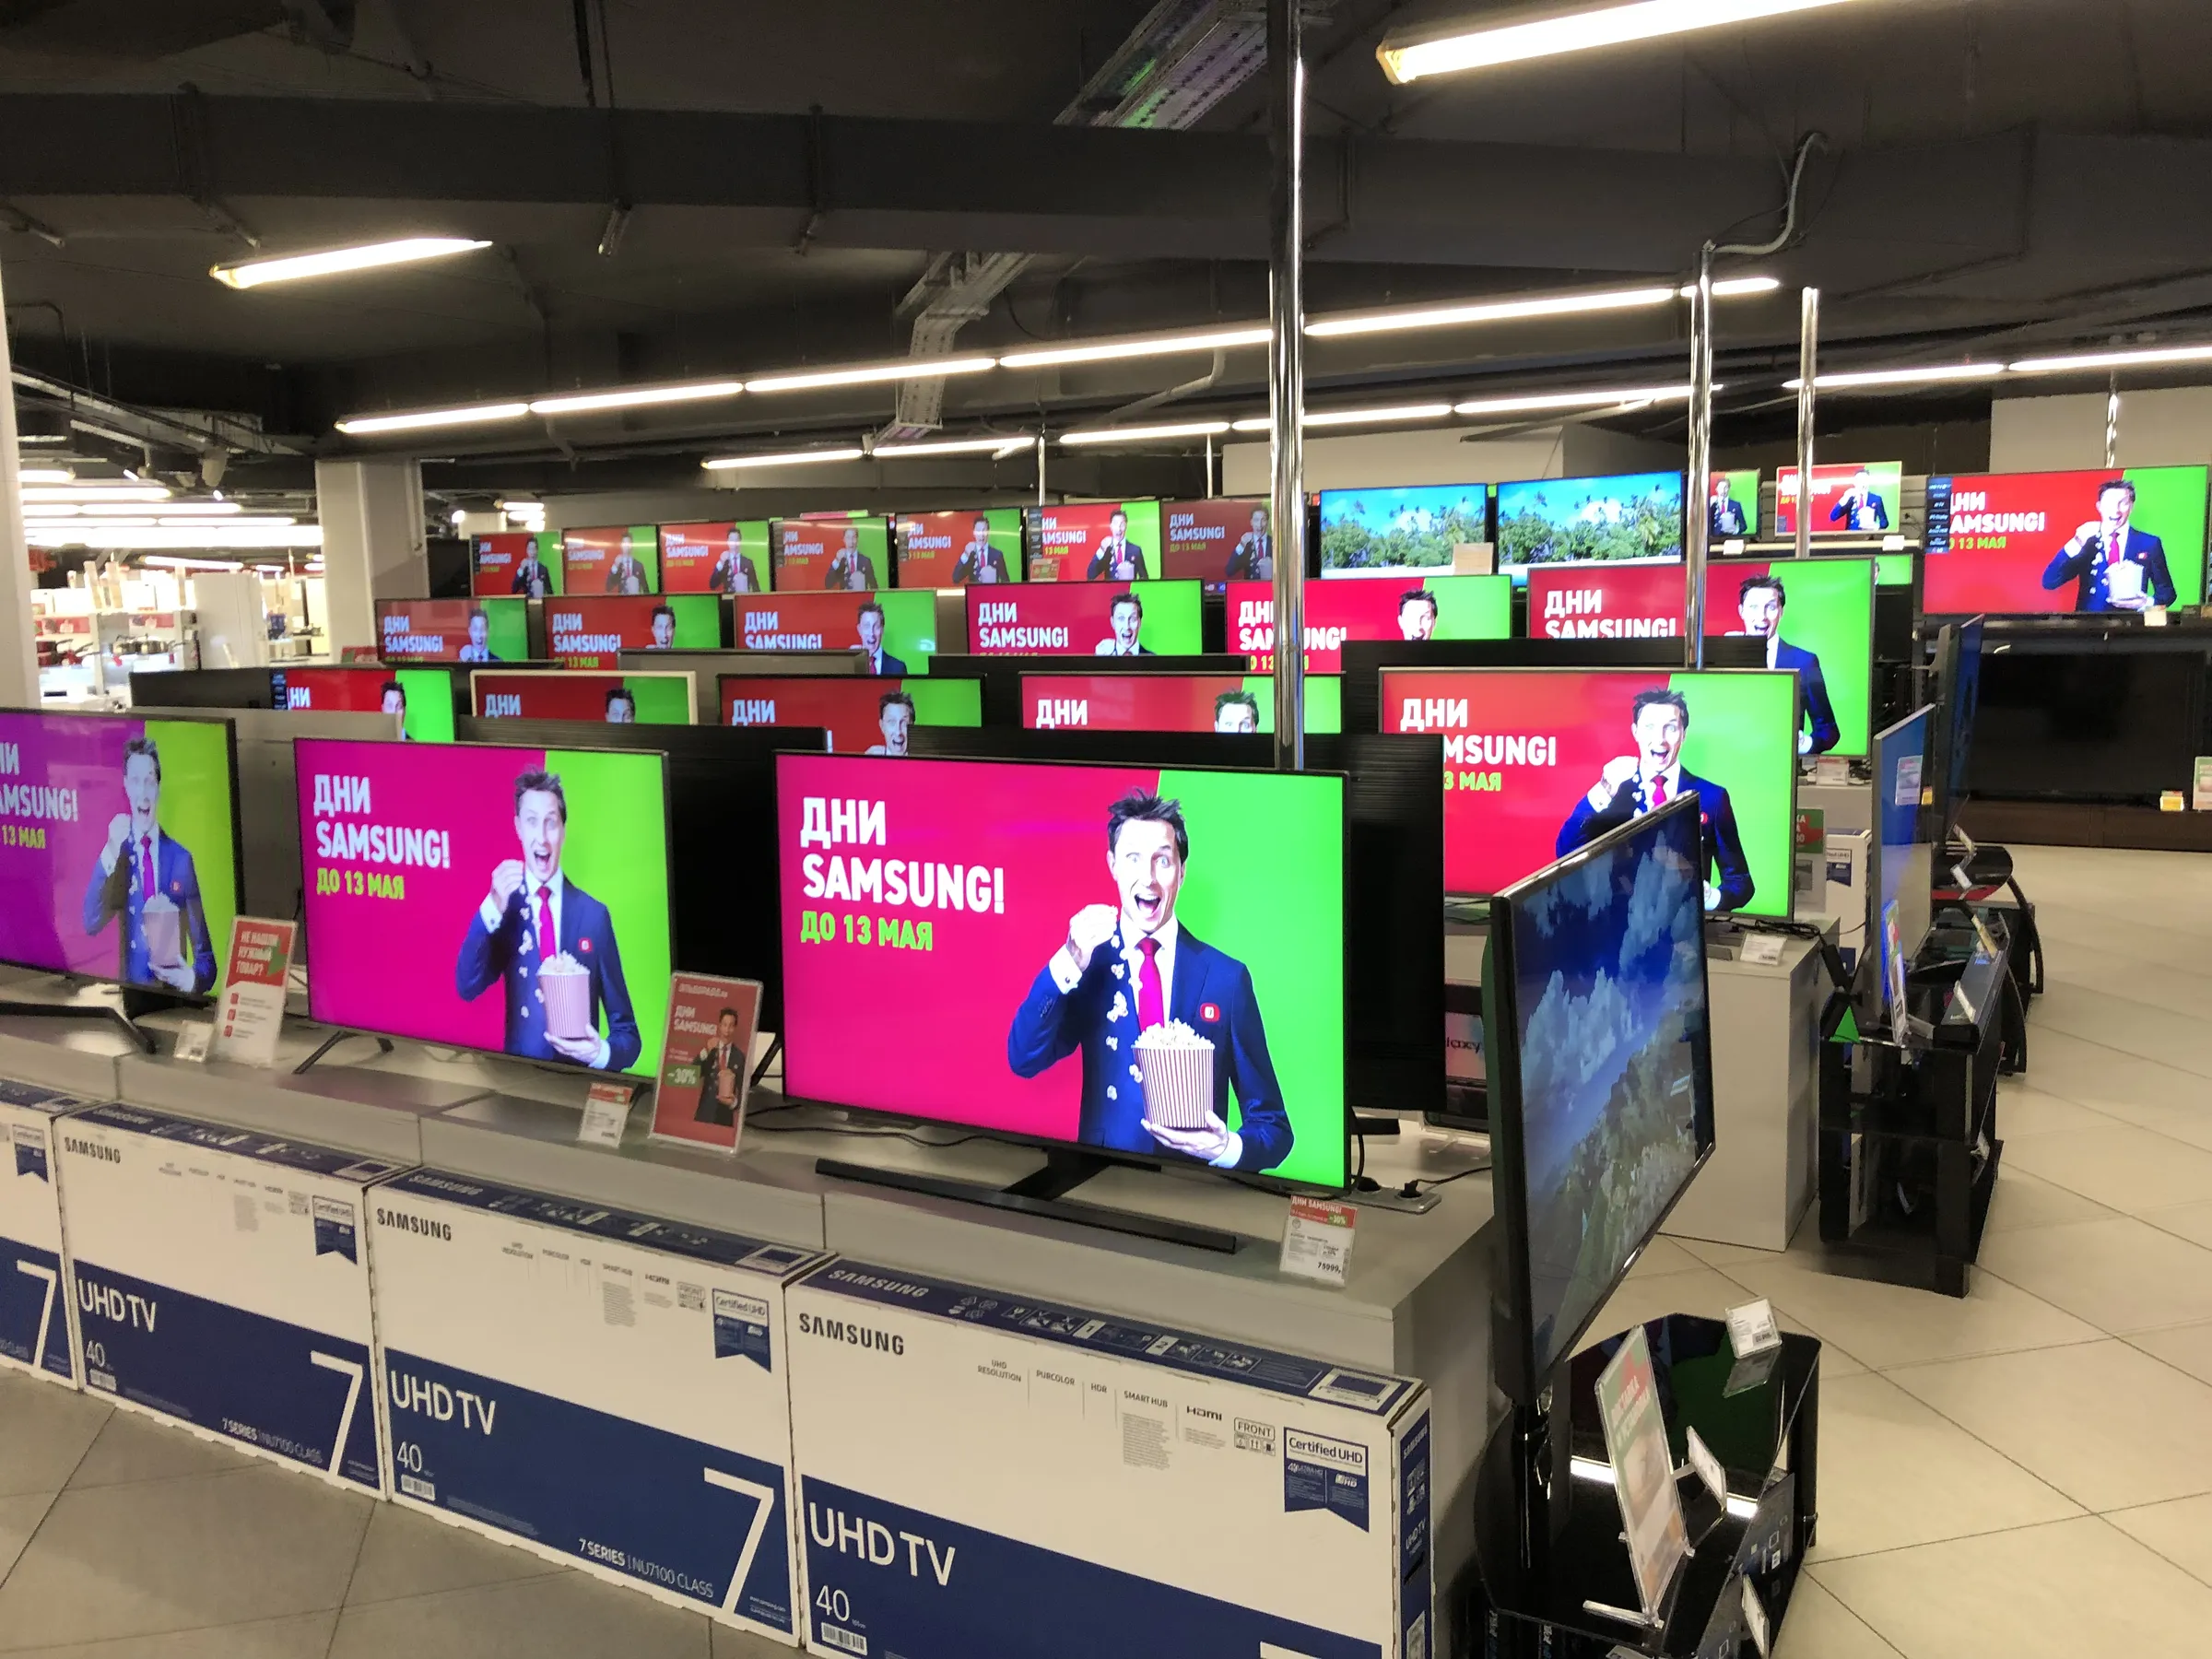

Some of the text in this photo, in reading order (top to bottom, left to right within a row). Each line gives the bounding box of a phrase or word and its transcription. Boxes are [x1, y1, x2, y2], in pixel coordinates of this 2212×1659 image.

[1042, 517, 1056, 530] НИ
[1169, 513, 1194, 529] ДНИ
[1949, 512, 2045, 534] AMSUNG!
[908, 535, 951, 549] AMSUNG!
[1042, 531, 1086, 545] AMSUNG!
[1170, 526, 1225, 541] SAMSUNG!
[1959, 536, 2006, 549] 13 МАЯ
[480, 553, 512, 564] AMSUNG!
[783, 543, 823, 555] AMSUNG!
[978, 602, 1017, 627] ДНИ
[1544, 589, 1602, 618] ДНИ
[383, 616, 409, 634] ДНИ
[553, 613, 582, 633] ДНИ
[745, 611, 778, 634] ДНИ
[1545, 618, 1677, 639] SAMSUNG!
[384, 635, 443, 653] SAMSUNG!
[554, 634, 621, 653] SAMSUNG!
[745, 634, 822, 650] SAMSUNG!
[979, 627, 1068, 648] SAMSUNG!
[568, 657, 578, 668] 13
[287, 687, 311, 710] НИ
[485, 694, 521, 718] ДНИ
[732, 700, 776, 726] ДНИ
[1036, 699, 1088, 729] ДНИ
[1400, 698, 1468, 732] ДНИ
[1443, 735, 1556, 766] MSUNG!
[1443, 771, 1501, 792] 3 МАЯ
[0, 782, 78, 822] MSUNG!
[313, 774, 371, 818] ДНИ
[800, 796, 886, 850] ДНИ
[2, 824, 46, 849] 13 МАЯ
[315, 820, 451, 869] SAMSUNG!
[316, 867, 405, 900] ДО 13 МАЯ
[803, 853, 1005, 914] SAMSUNG!
[800, 911, 933, 951] ДО 13 МАЯ
[1447, 1037, 1480, 1053] laxy
[667, 1068, 697, 1084] -30%
[65, 1136, 121, 1164] SAMSUNG
[1292, 1196, 1307, 1206] ДНИ
[377, 1207, 452, 1241] SAMSUNG
[829, 1269, 929, 1299] SAMSUNG
[17, 1259, 57, 1368] 7
[77, 1279, 157, 1333] UHD TV
[799, 1313, 904, 1356] SAMSUNG
[86, 1340, 105, 1368] 40
[992, 1359, 1007, 1369] UHD
[977, 1365, 1021, 1382] RESOLUTION
[1036, 1370, 1075, 1385] PURCOLOR
[1090, 1383, 1107, 1394] HDR
[1124, 1391, 1168, 1408] SMART HUB
[311, 1350, 363, 1475] 7
[390, 1371, 497, 1436] UHD TV
[222, 1418, 228, 1430] 7
[1238, 1421, 1272, 1437] FRONT
[396, 1441, 423, 1474] 40
[1288, 1437, 1363, 1464] Certified UHD
[704, 1466, 774, 1613] 7
[809, 1501, 956, 1587] UHD TV
[579, 1537, 714, 1598] 7 SERIES NU7100 CLASS
[816, 1585, 850, 1622] 40
